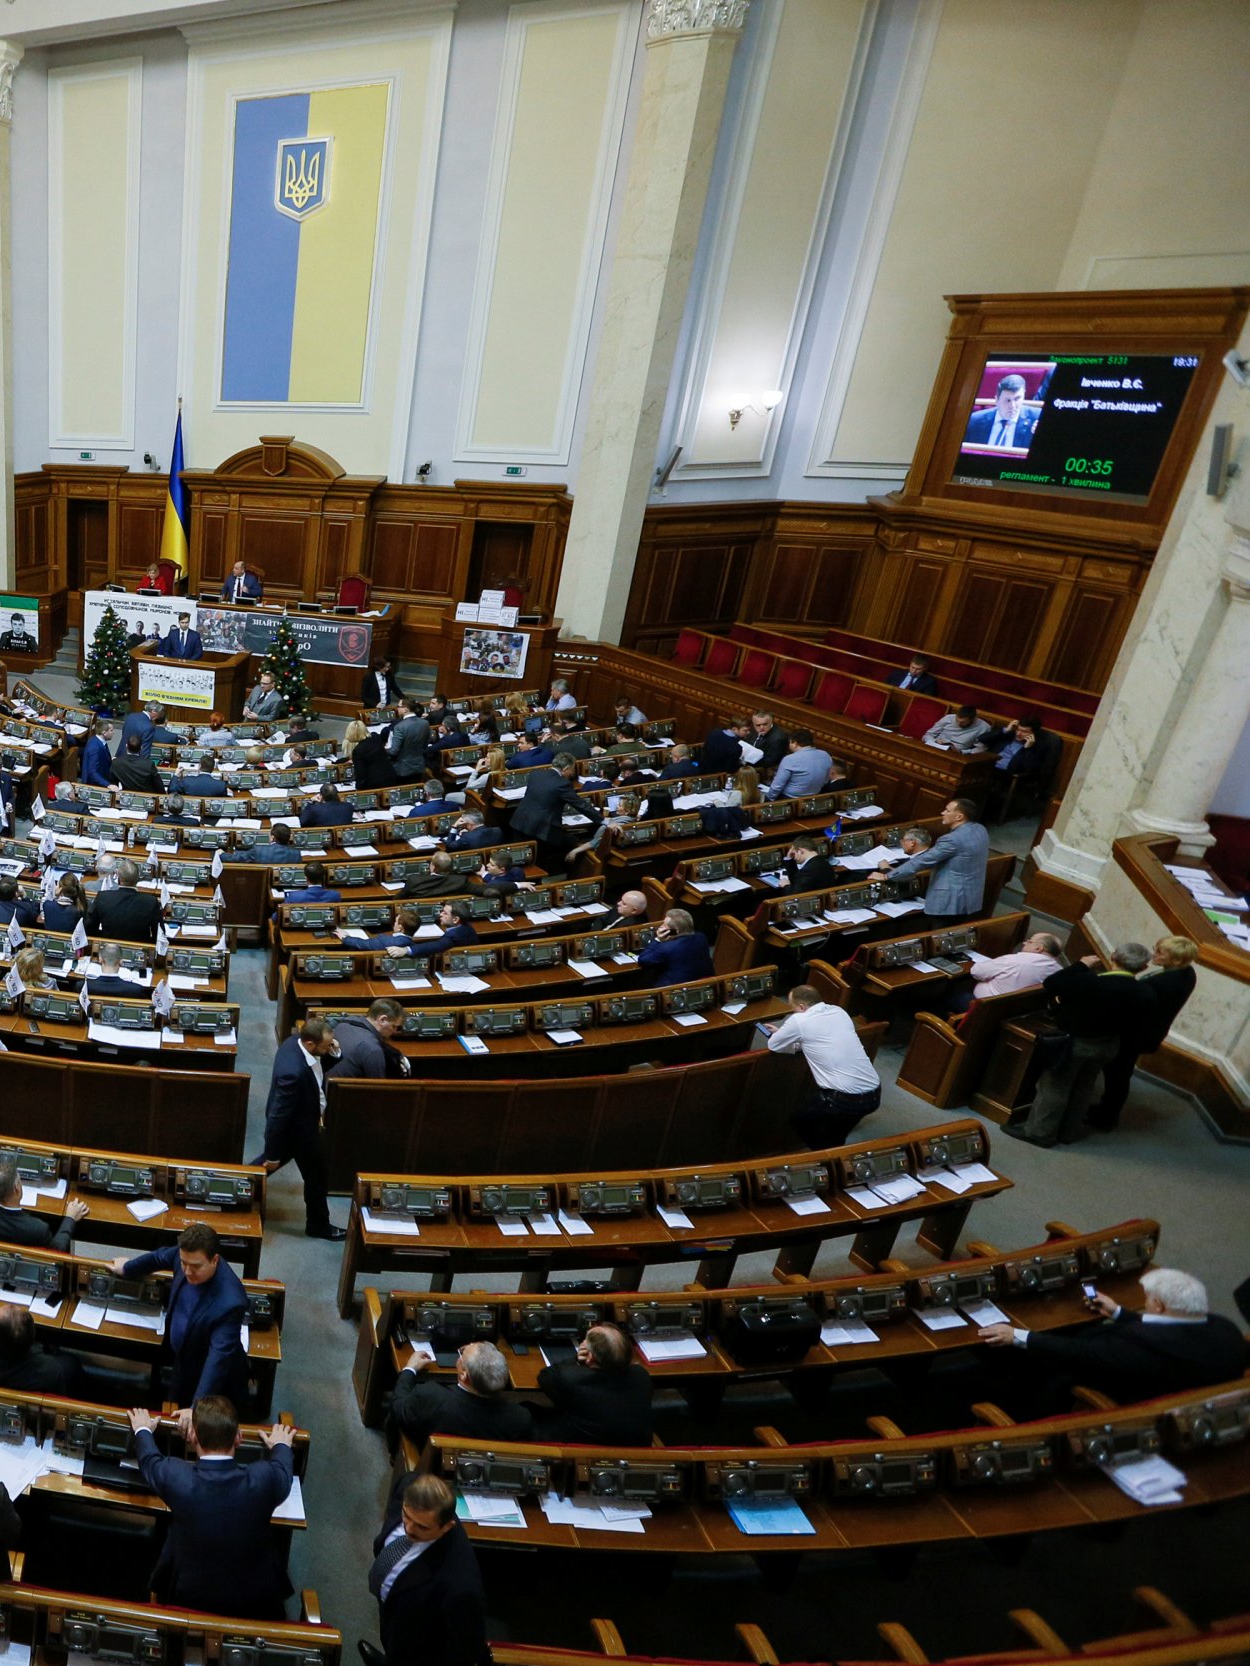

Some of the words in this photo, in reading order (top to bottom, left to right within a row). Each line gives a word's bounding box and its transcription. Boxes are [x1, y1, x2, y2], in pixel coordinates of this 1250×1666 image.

[1065, 457, 1114, 475] 00:35
[1000, 471, 1050, 483] регламент
[1069, 478, 1111, 489] хвилина
